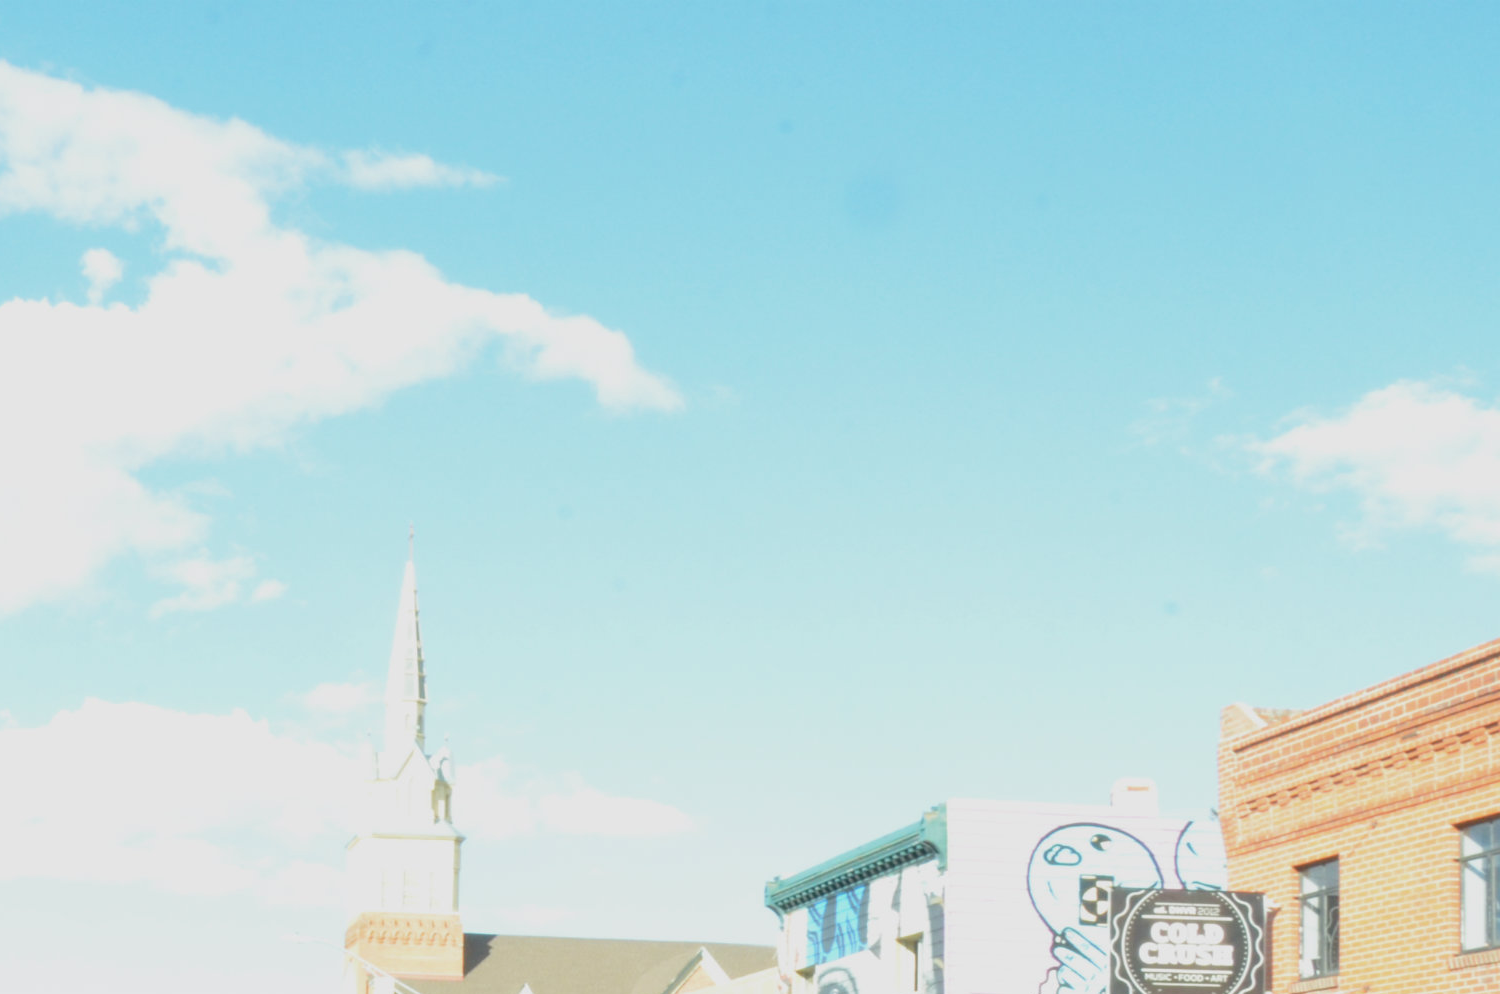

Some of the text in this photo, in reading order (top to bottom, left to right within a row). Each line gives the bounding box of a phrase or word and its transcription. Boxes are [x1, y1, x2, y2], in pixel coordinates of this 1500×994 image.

[1197, 907, 1220, 916] 2012
[1150, 921, 1225, 945] COLD
[1138, 942, 1234, 966] CRUSH
[1144, 973, 1229, 982] MUSIC FOOD ART
